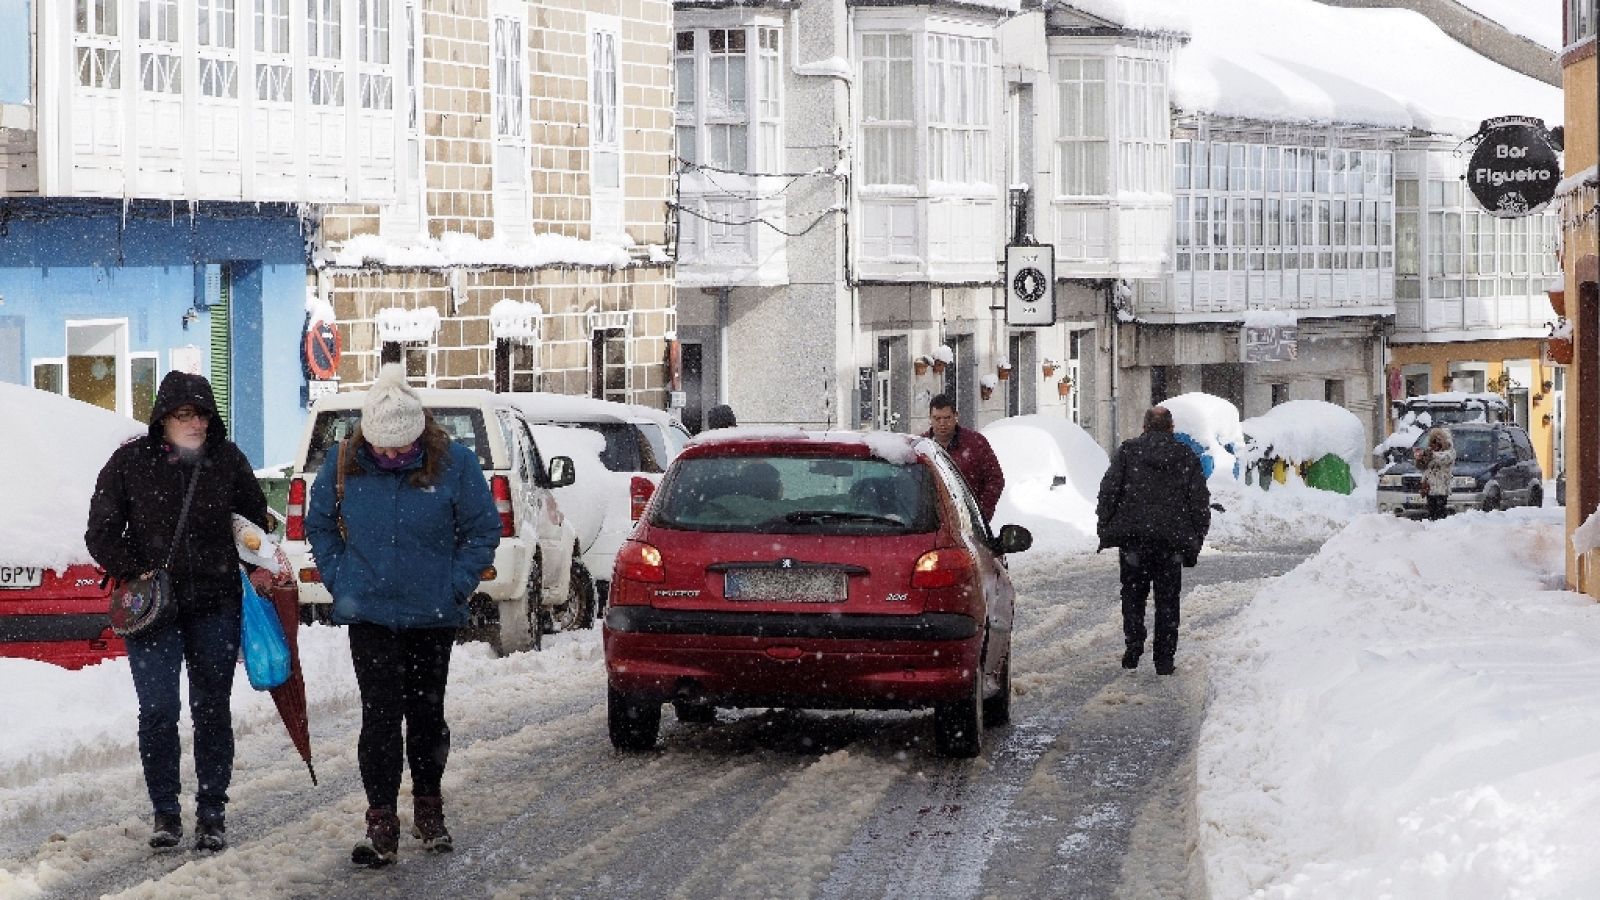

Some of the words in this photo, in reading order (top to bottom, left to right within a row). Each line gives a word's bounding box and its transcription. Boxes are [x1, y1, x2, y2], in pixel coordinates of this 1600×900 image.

[1496, 144, 1529, 159] Bar
[1475, 167, 1551, 187] Figueiro
[1, 566, 35, 584] GPV
